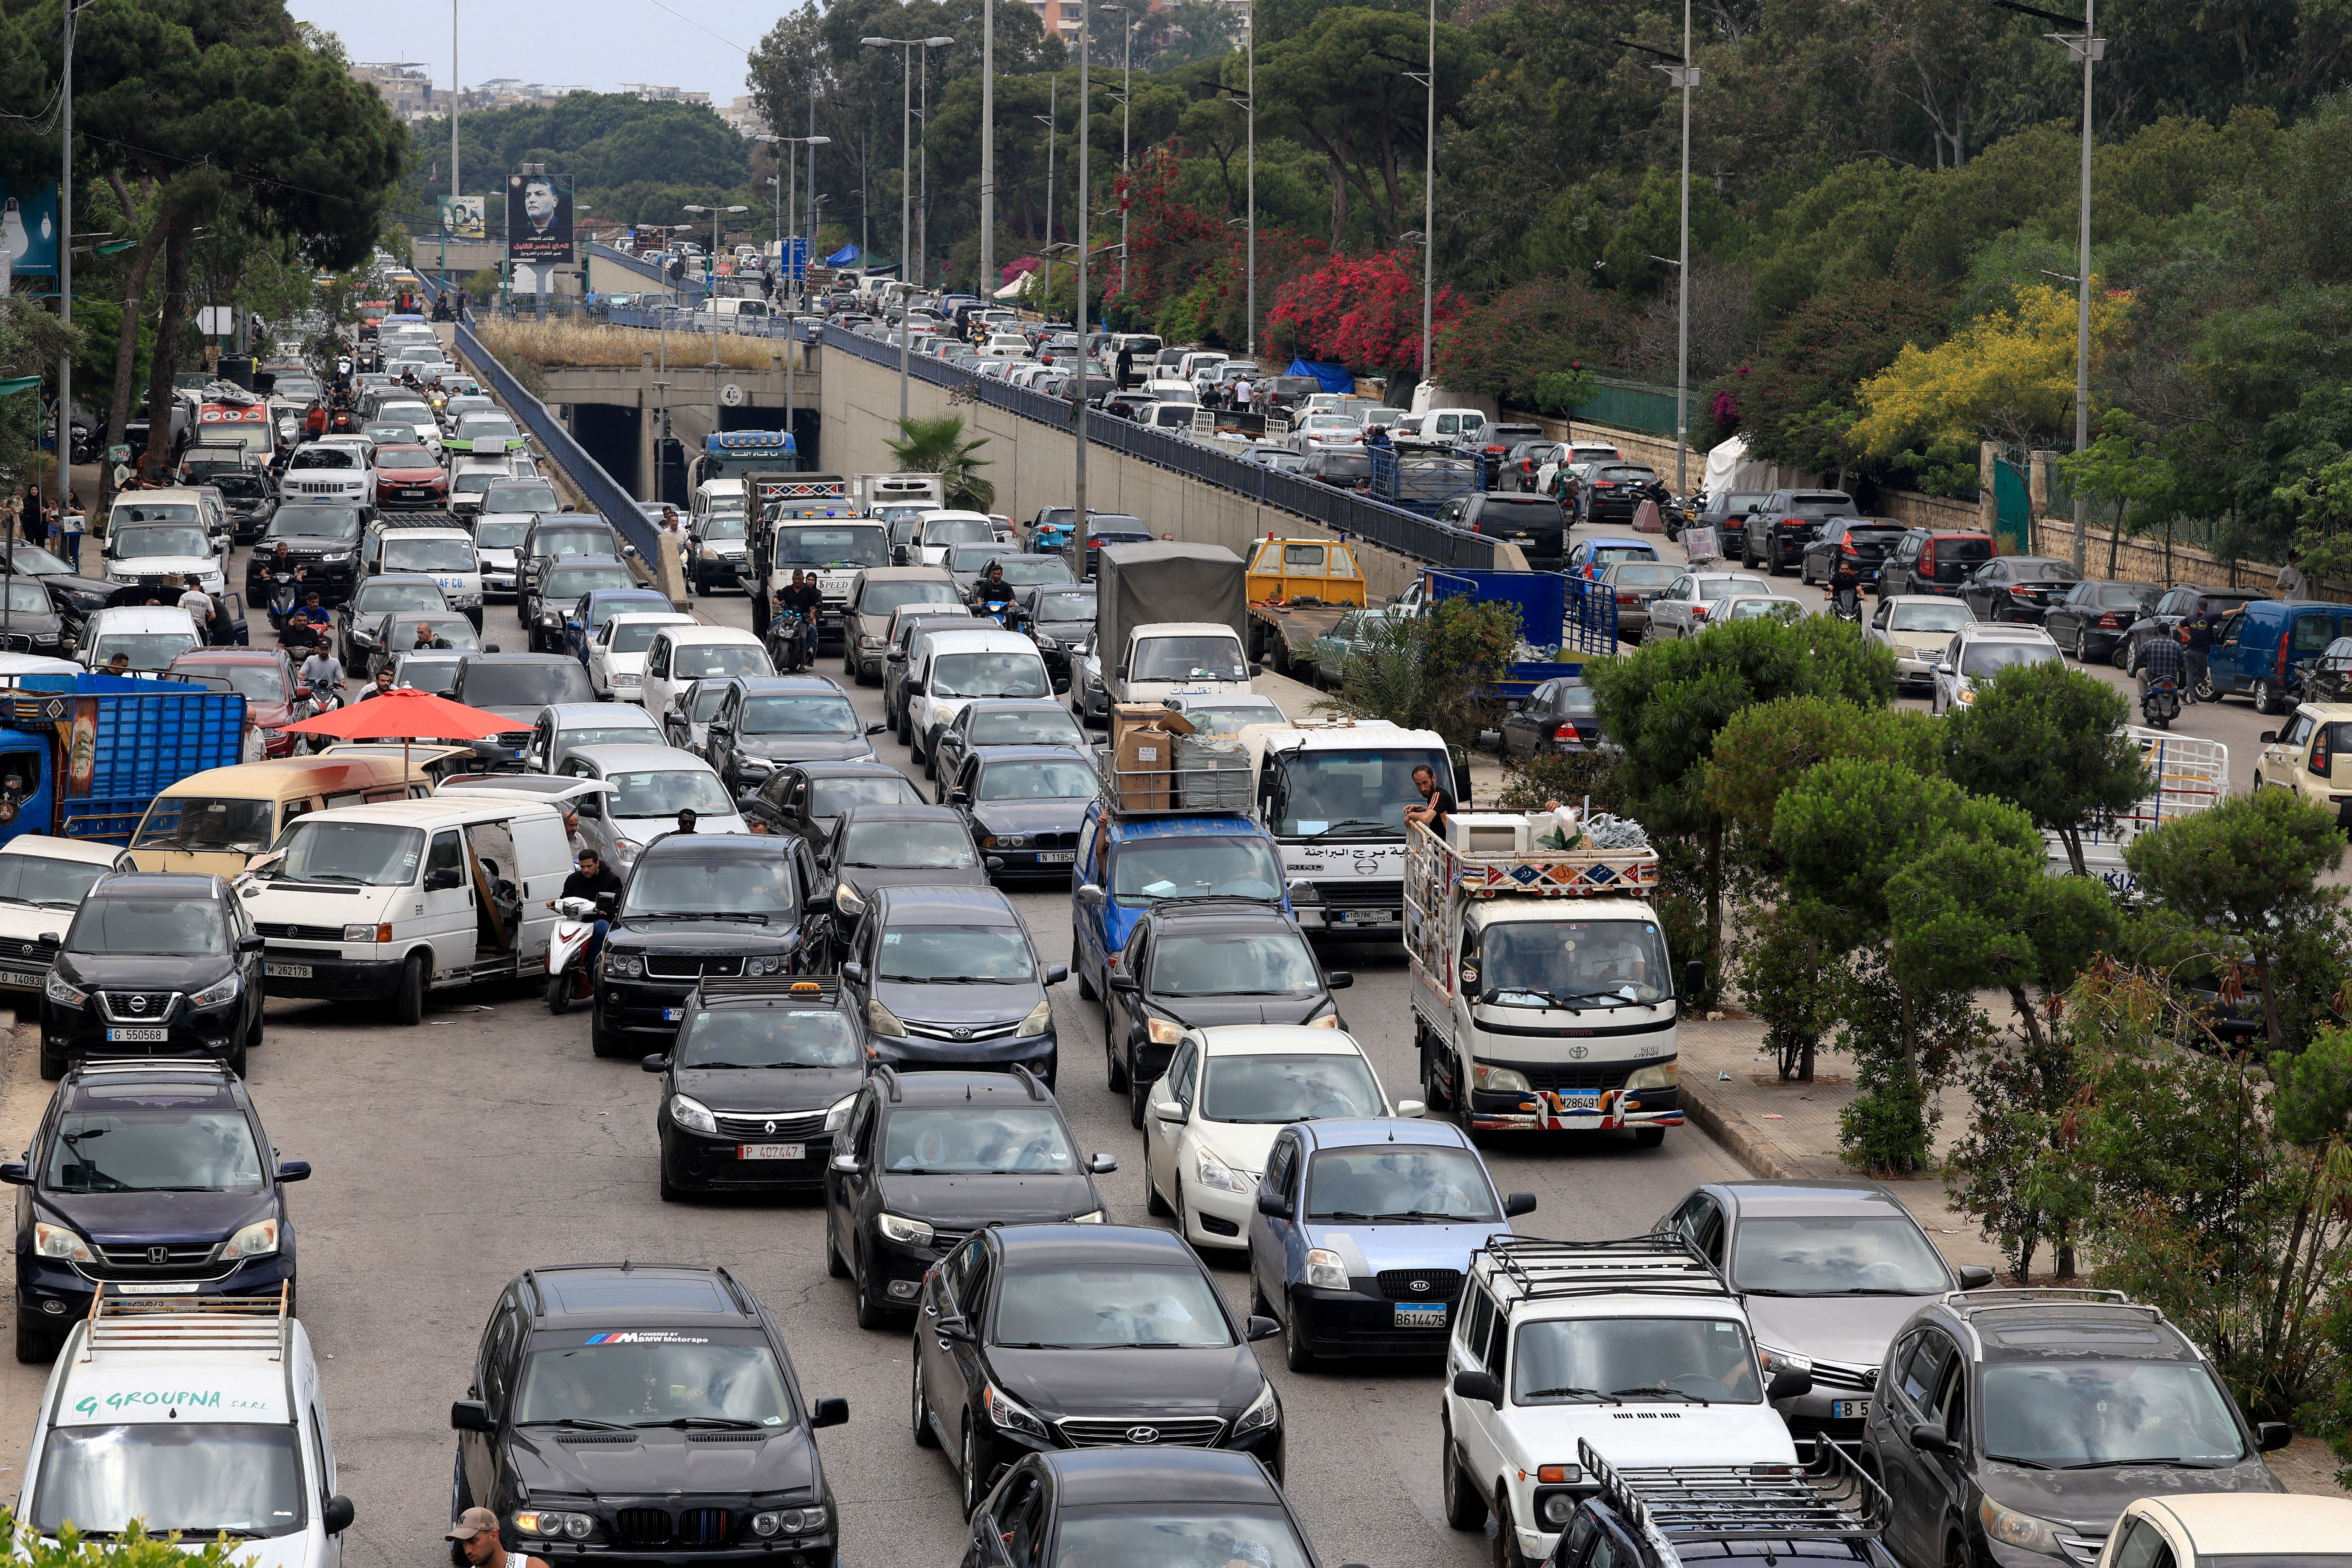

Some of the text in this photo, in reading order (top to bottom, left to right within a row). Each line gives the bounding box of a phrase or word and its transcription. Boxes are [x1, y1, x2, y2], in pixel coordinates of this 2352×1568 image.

[452, 578, 466, 588] CO.
[818, 580, 848, 589] SPEED
[1170, 687, 1211, 695] نقليات
[1042, 853, 1047, 862] N
[1305, 848, 1348, 858] البراجنة
[1353, 850, 1386, 859] برج
[1287, 863, 1324, 871] HINO
[2104, 872, 2137, 890] KIA
[268, 966, 307, 977] M 262178
[115, 1030, 161, 1039] G 550568
[1560, 1098, 1598, 1108] M286491
[746, 1146, 797, 1158] P 407447
[1396, 1314, 1445, 1326] B614475
[106, 1390, 221, 1409] GROUPNA
[230, 1400, 269, 1411] S.A.R.L.
[1844, 1403, 1853, 1416] B
